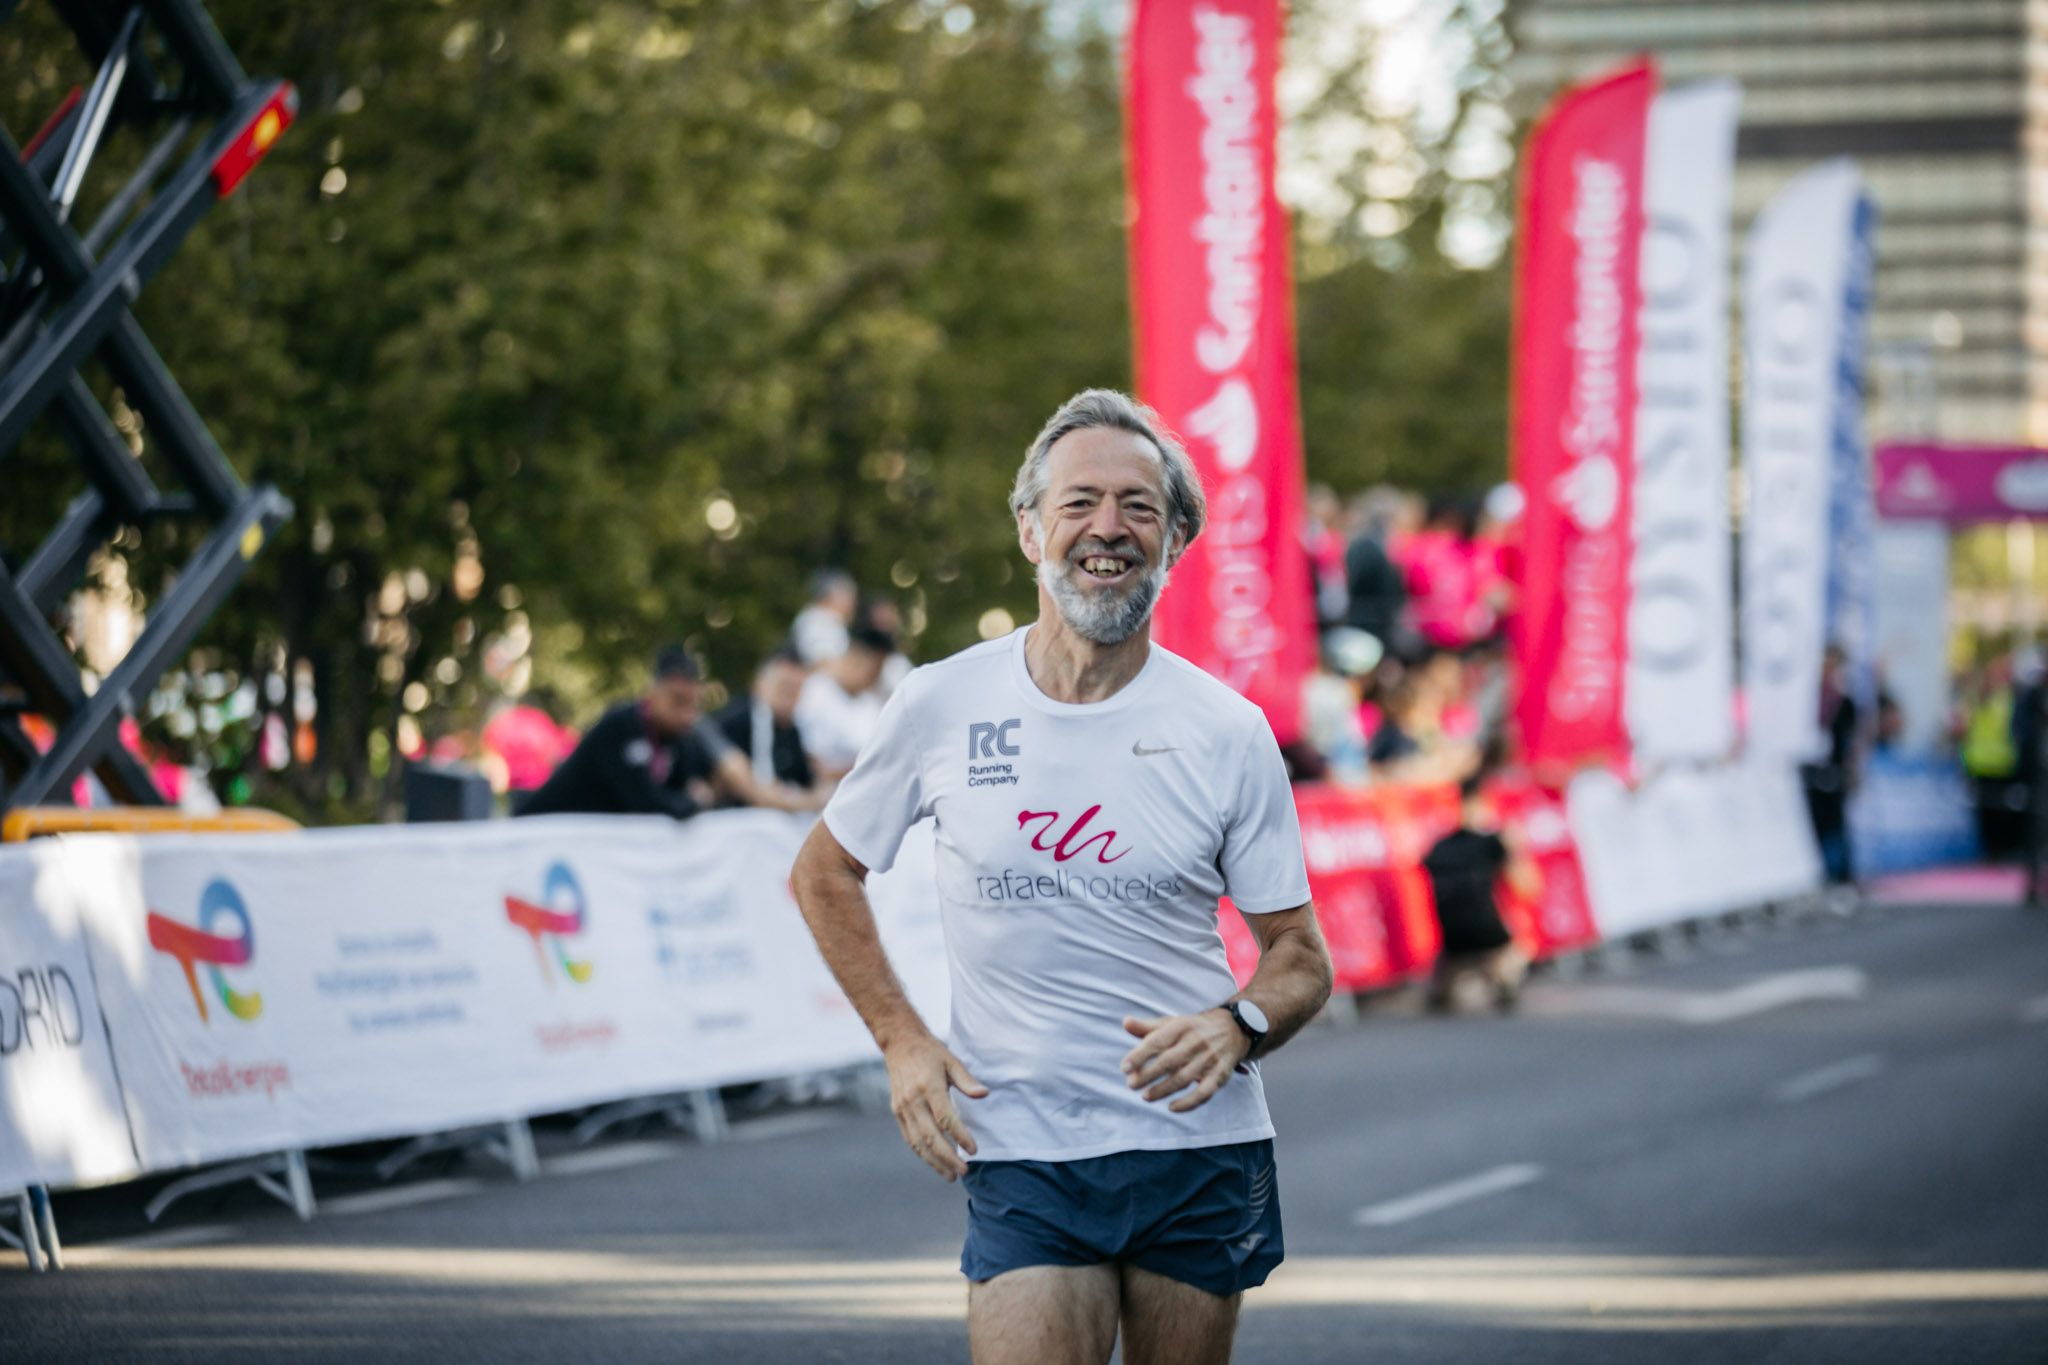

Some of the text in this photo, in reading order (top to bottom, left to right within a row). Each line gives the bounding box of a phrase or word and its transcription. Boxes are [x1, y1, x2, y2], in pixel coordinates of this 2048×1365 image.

[1187, 6, 1264, 372] Santander
[969, 718, 1021, 760] RC
[968, 776, 1019, 787] Company
[969, 764, 1012, 776] Running
[976, 868, 1184, 901] rafaelhoteles
